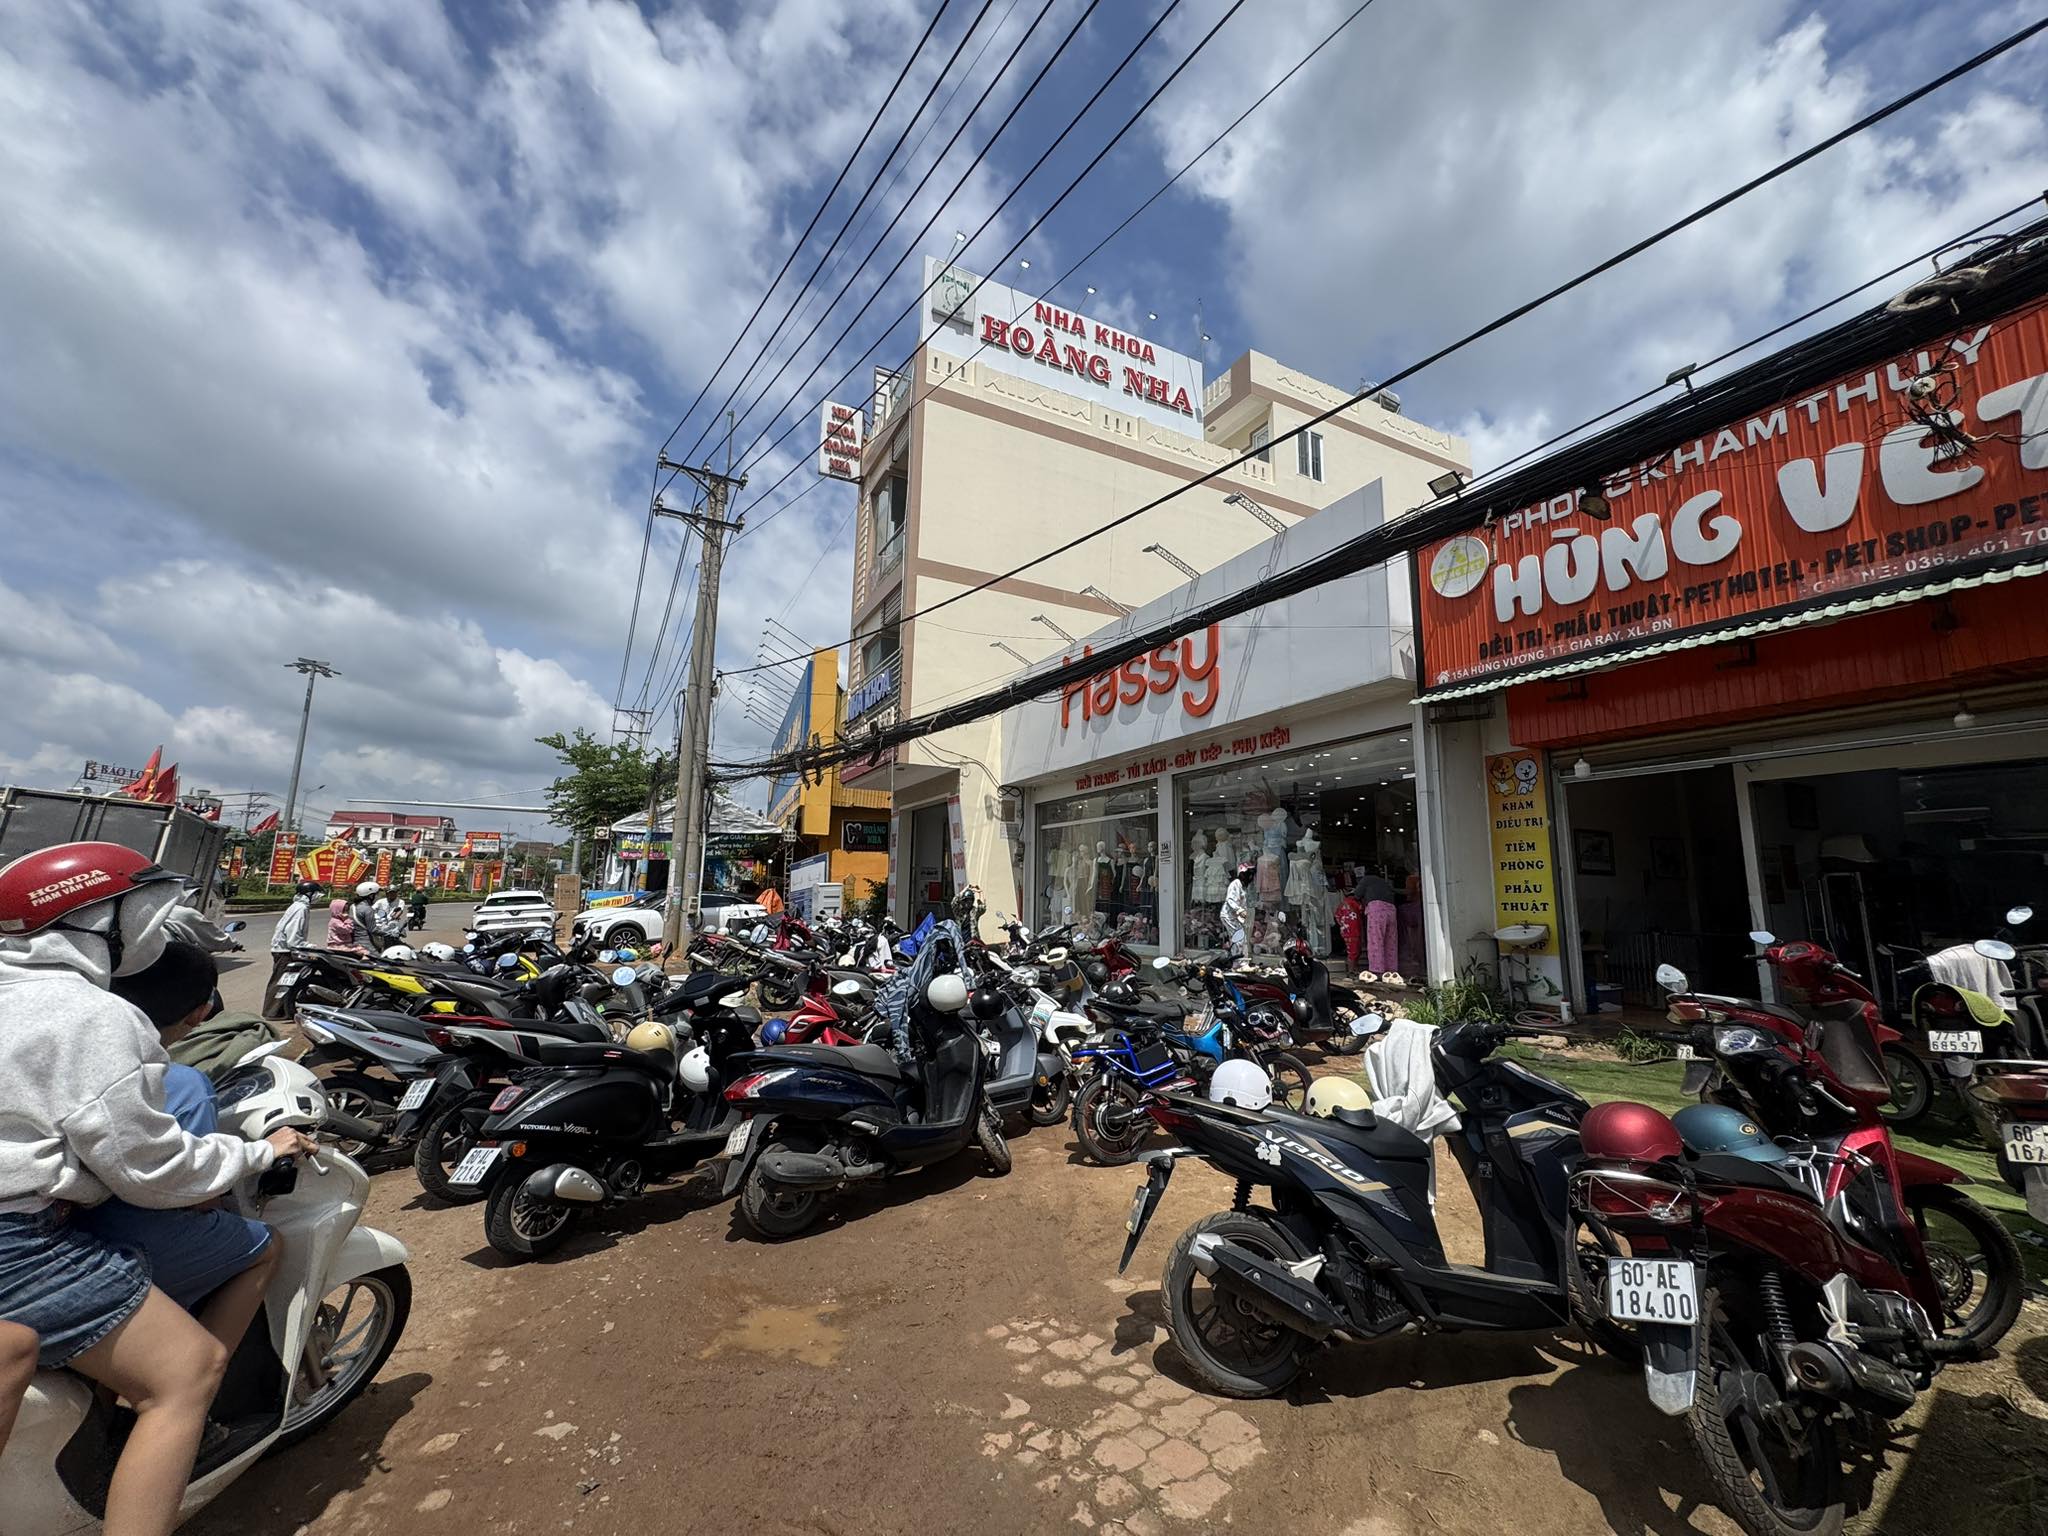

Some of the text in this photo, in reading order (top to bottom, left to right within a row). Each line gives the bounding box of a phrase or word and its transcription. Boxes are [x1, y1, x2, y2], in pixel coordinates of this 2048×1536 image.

[1035, 303, 1156, 364] NHA KHOA
[980, 313, 1193, 414] HOÀNG NHA
[1683, 578, 1724, 609] PET
[1727, 562, 1804, 598] HOTEL
[1825, 537, 1879, 574] PET
[1886, 514, 1972, 557] SHOP
[1994, 491, 2048, 531] PE
[1452, 668, 1470, 680] 15A
[1570, 635, 1593, 651] GIA
[1652, 617, 1673, 632] ĐN
[1060, 621, 1220, 729] Hassy
[1231, 736, 1257, 755] PHỤ
[1259, 726, 1291, 749] KIỆN
[1524, 817, 1543, 828] TRỊ
[1505, 840, 1536, 852] TIÊM
[1500, 859, 1545, 871] PHÒNG
[27, 869, 107, 900] HONDA
[31, 891, 62, 907] PHẠM
[1501, 900, 1549, 914] THUẬT
[1932, 1041, 1978, 1051] 685.97
[520, 1123, 550, 1131] VICTORIA
[1545, 1109, 1572, 1123] HONDA
[1265, 1129, 1366, 1182] VARIO
[1621, 1261, 1681, 1290] 60-AE
[1616, 1289, 1693, 1321] 184.00
